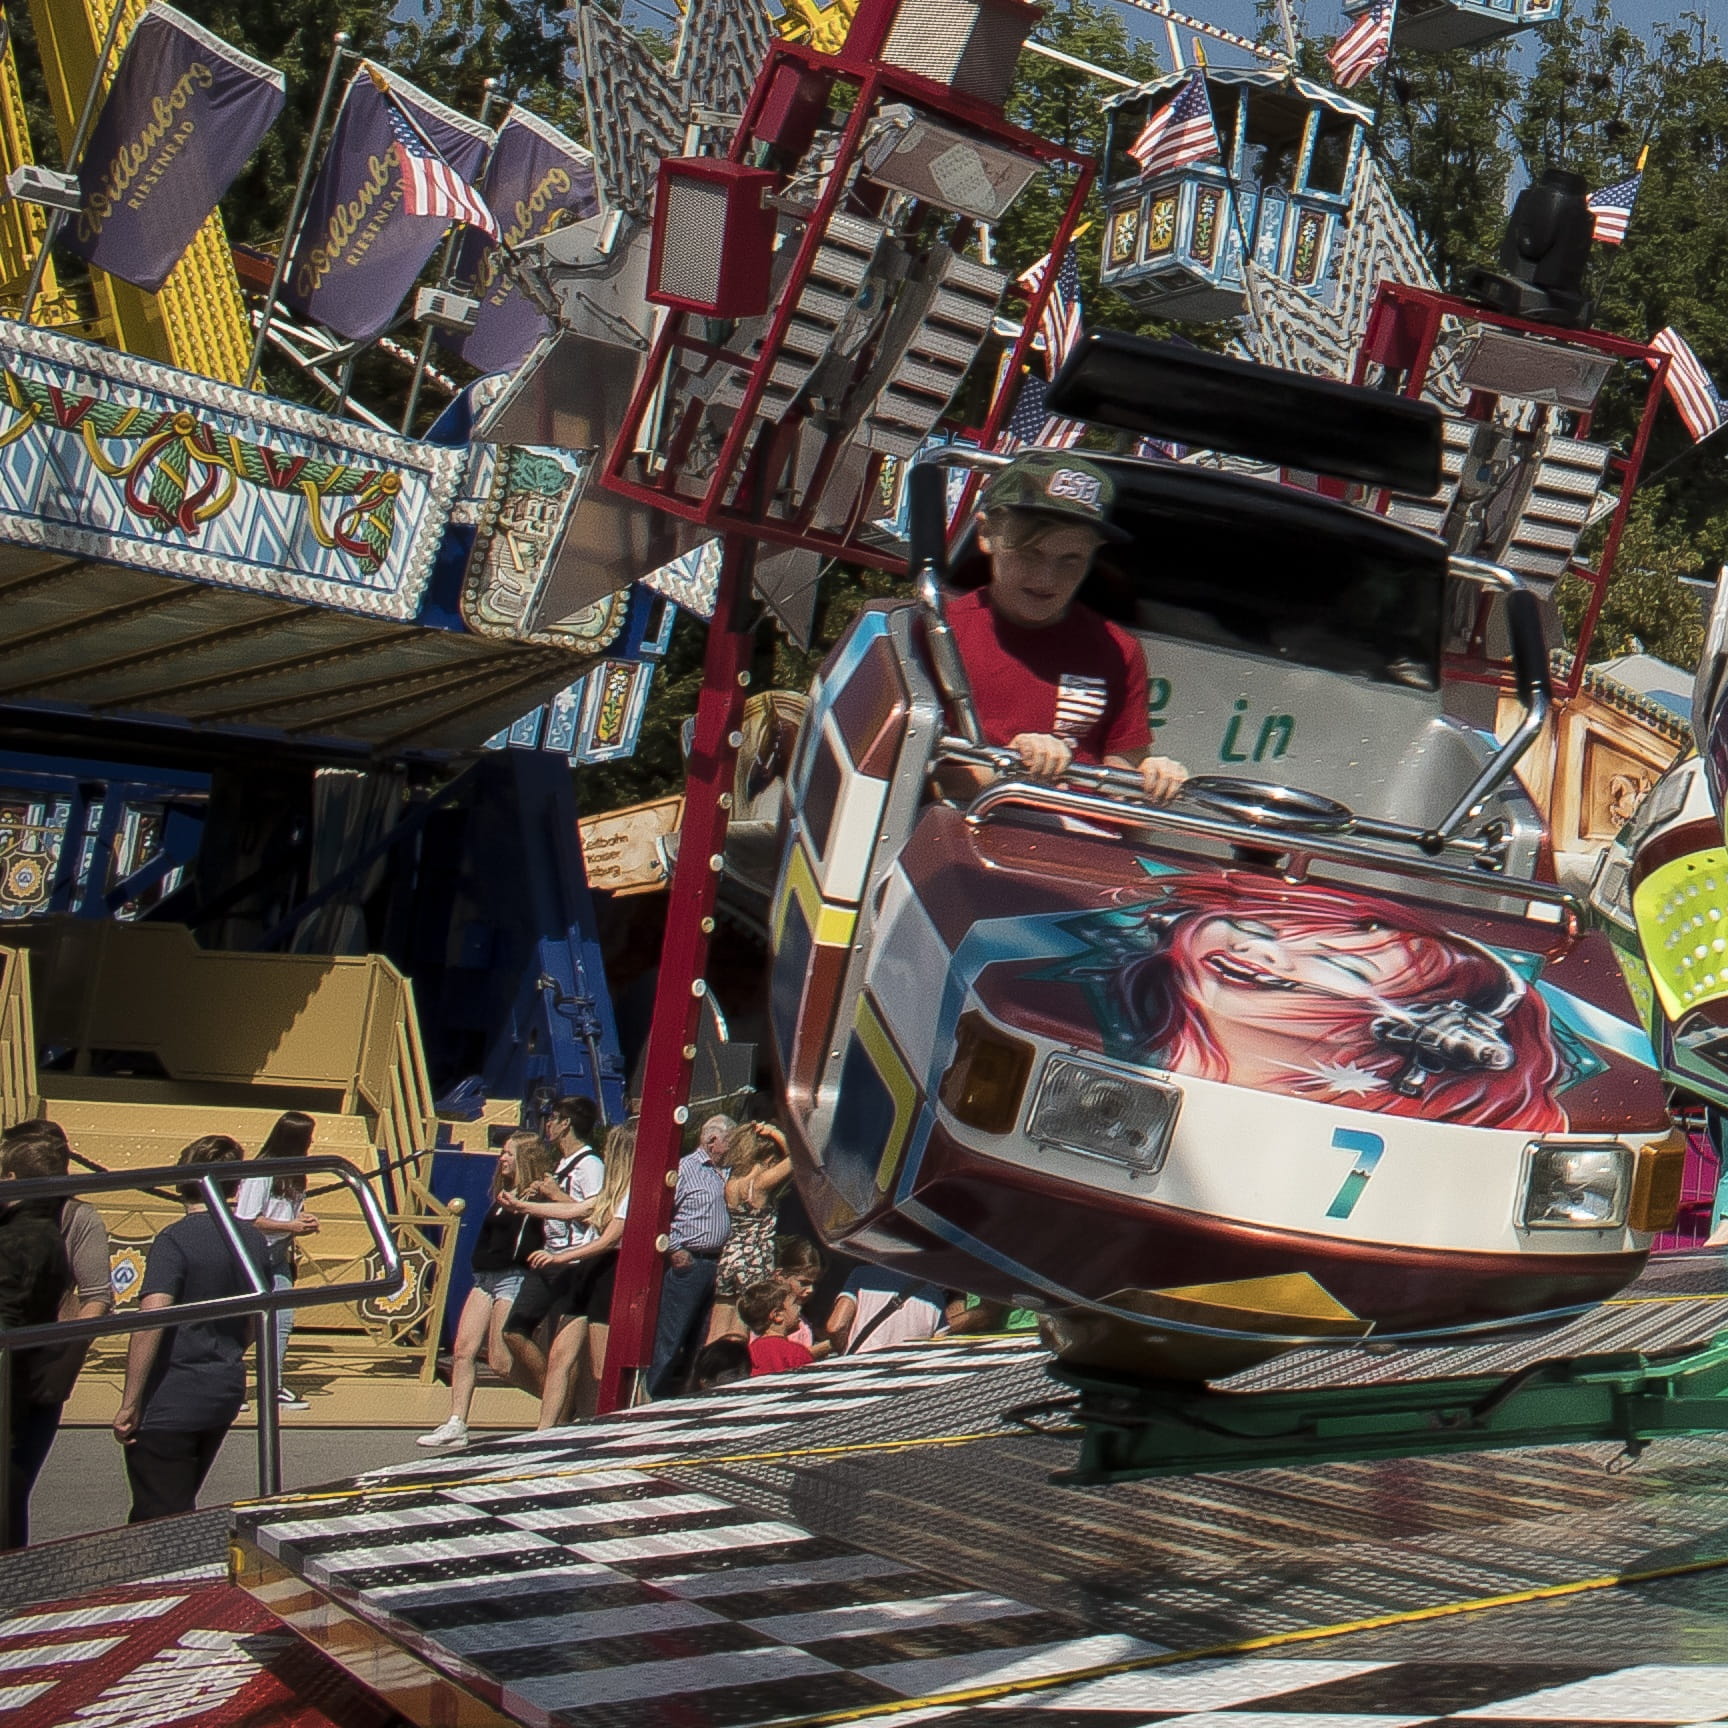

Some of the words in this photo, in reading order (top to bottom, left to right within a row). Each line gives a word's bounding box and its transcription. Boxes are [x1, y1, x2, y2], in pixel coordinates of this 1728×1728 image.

[77, 62, 213, 243] Willenborg
[127, 121, 195, 211] RIESENRAD
[298, 141, 401, 298] Willenbo
[1218, 698, 1296, 763] in
[1324, 1125, 1386, 1221] 7
